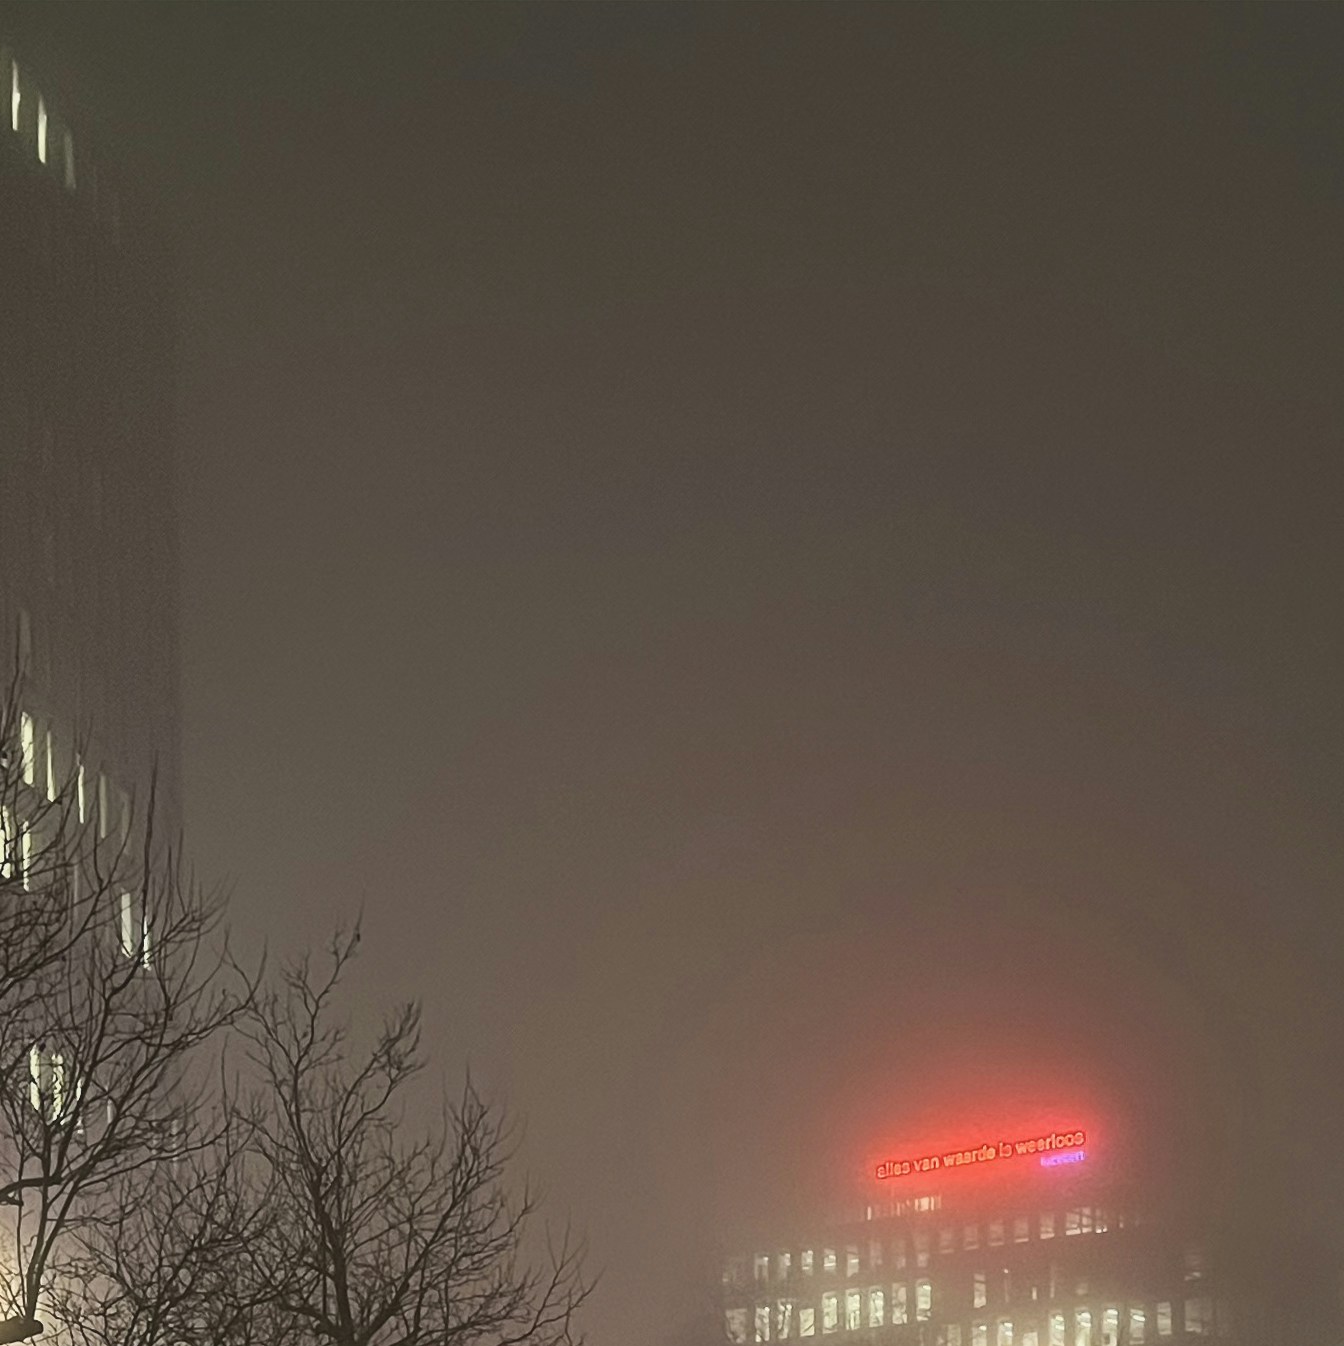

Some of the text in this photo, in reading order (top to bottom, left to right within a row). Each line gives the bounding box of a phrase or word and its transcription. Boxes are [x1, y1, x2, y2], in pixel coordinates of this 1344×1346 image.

[876, 1161, 910, 1179] alles
[913, 1156, 940, 1173] van
[943, 1144, 996, 1168] waarde
[1015, 1131, 1085, 1155] weerloos
